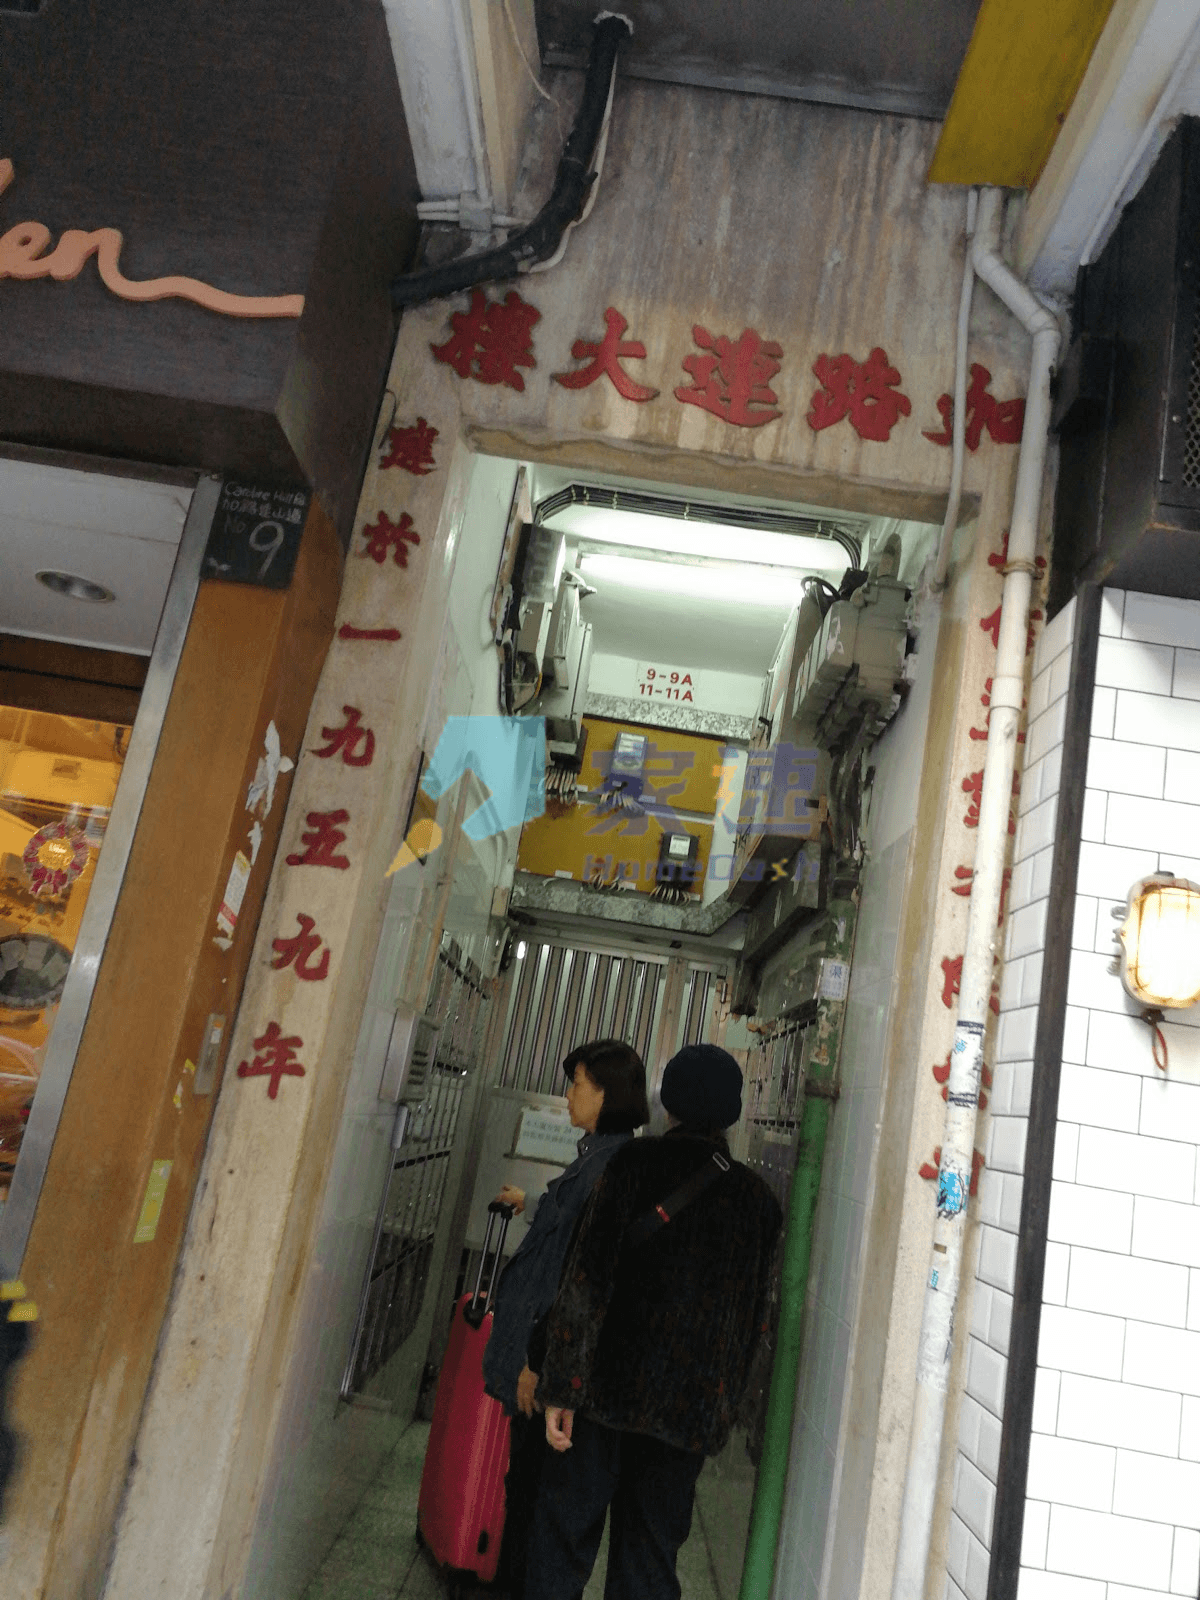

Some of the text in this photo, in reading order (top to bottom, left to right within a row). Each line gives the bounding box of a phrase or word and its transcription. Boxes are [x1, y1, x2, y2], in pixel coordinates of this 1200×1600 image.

[0, 158, 305, 318] en
[430, 288, 1025, 452] 加路連大樓
[248, 520, 285, 580] 9
[639, 683, 693, 703] 11-11A
[646, 668, 693, 686] 9-9A
[237, 416, 438, 1099] 建於一九五九年
